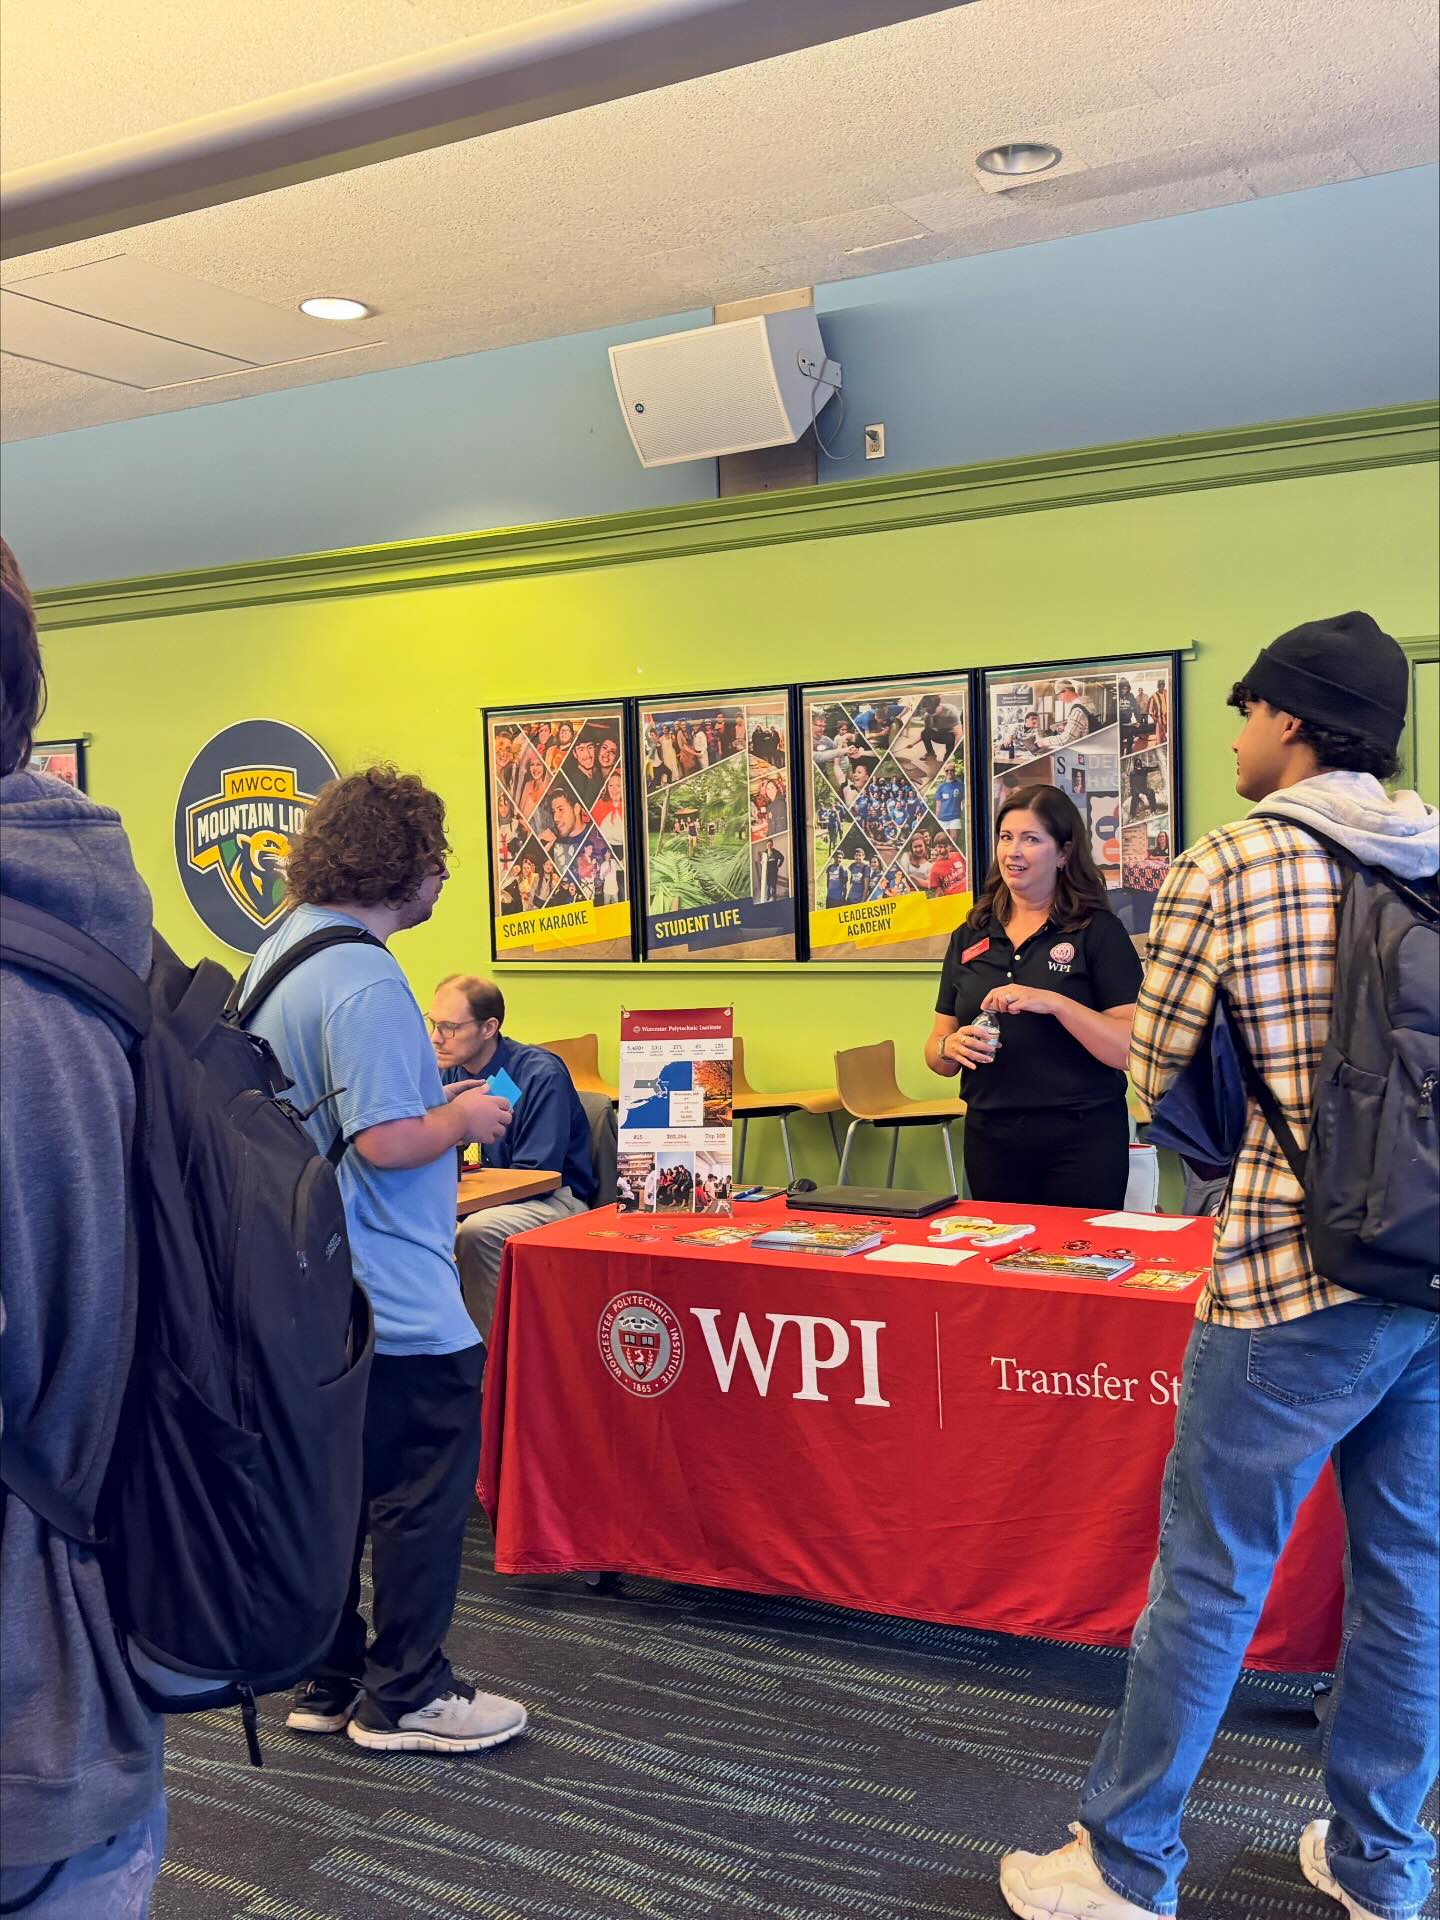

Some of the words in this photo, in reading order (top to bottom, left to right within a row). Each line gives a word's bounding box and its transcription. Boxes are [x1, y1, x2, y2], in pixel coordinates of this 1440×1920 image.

[231, 776, 287, 795] MWCC
[197, 803, 274, 847] MOUNTAIN
[278, 803, 309, 835] LIO
[503, 919, 536, 938] SCARY
[539, 910, 589, 932] KARAOKE
[654, 914, 710, 939] STUDENT
[712, 908, 742, 929] LIFE
[838, 902, 897, 924] LEADERSHIP
[847, 918, 891, 937] ACADEMY
[1047, 961, 1072, 973] WPI
[668, 1025, 698, 1033] Polytechnic
[601, 1312, 622, 1378] WORCESTER
[612, 1295, 672, 1325] POLYTECHNIC
[660, 1327, 681, 1384] INSTITUTE
[689, 1307, 891, 1408] WPI
[632, 1382, 652, 1393] 1865
[990, 1356, 1139, 1402] Transfer
